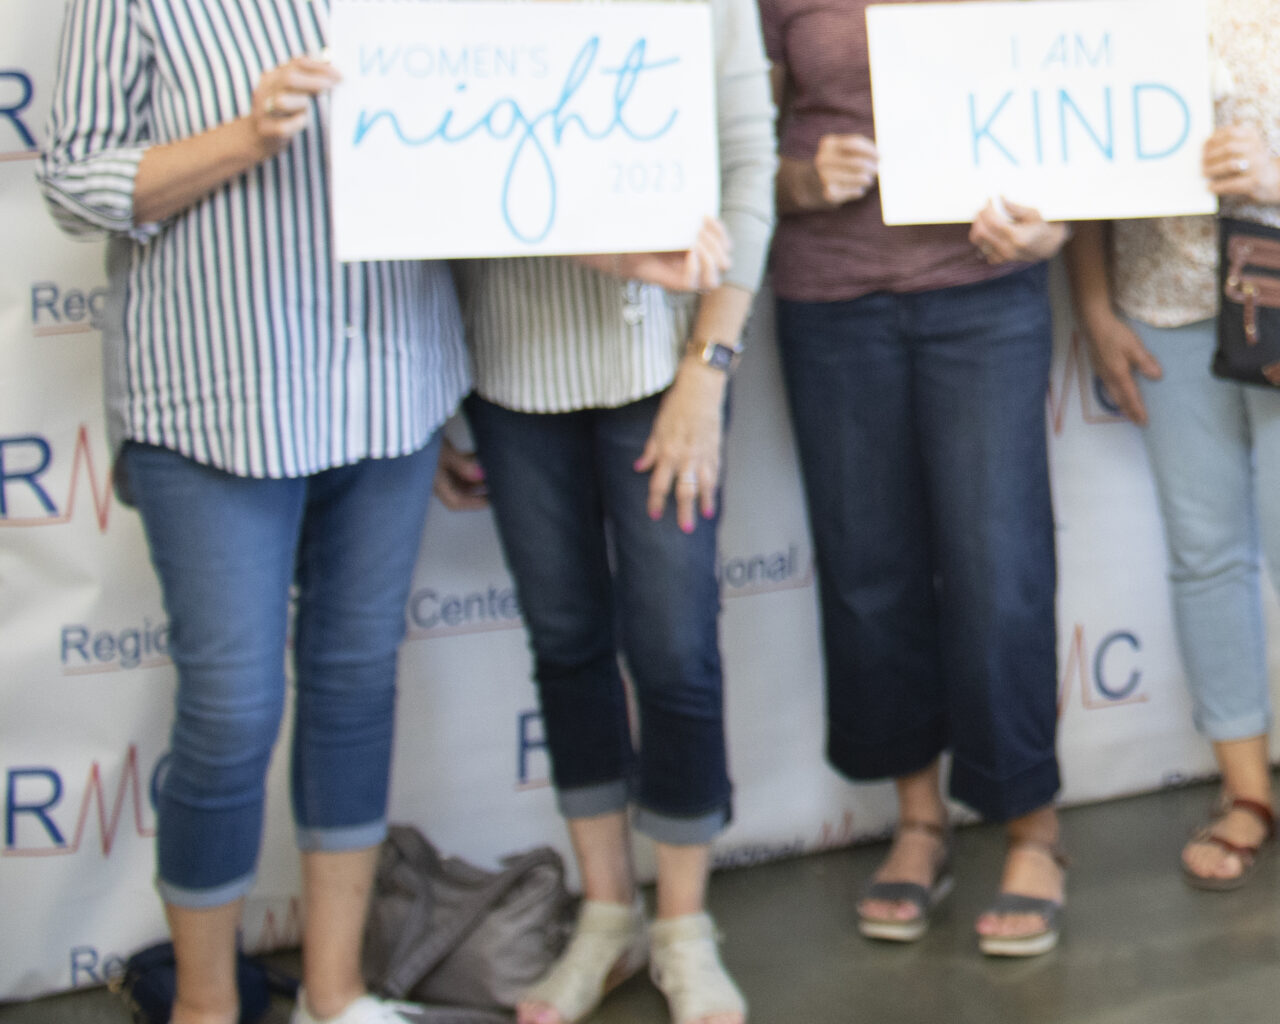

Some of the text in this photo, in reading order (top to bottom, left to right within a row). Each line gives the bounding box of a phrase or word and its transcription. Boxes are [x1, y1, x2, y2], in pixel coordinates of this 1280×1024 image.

[357, 42, 549, 78] WOMEN'S
[1009, 31, 1112, 70] I AM
[353, 34, 681, 245] night
[968, 83, 1191, 167] KIND
[410, 587, 518, 629] Cente
